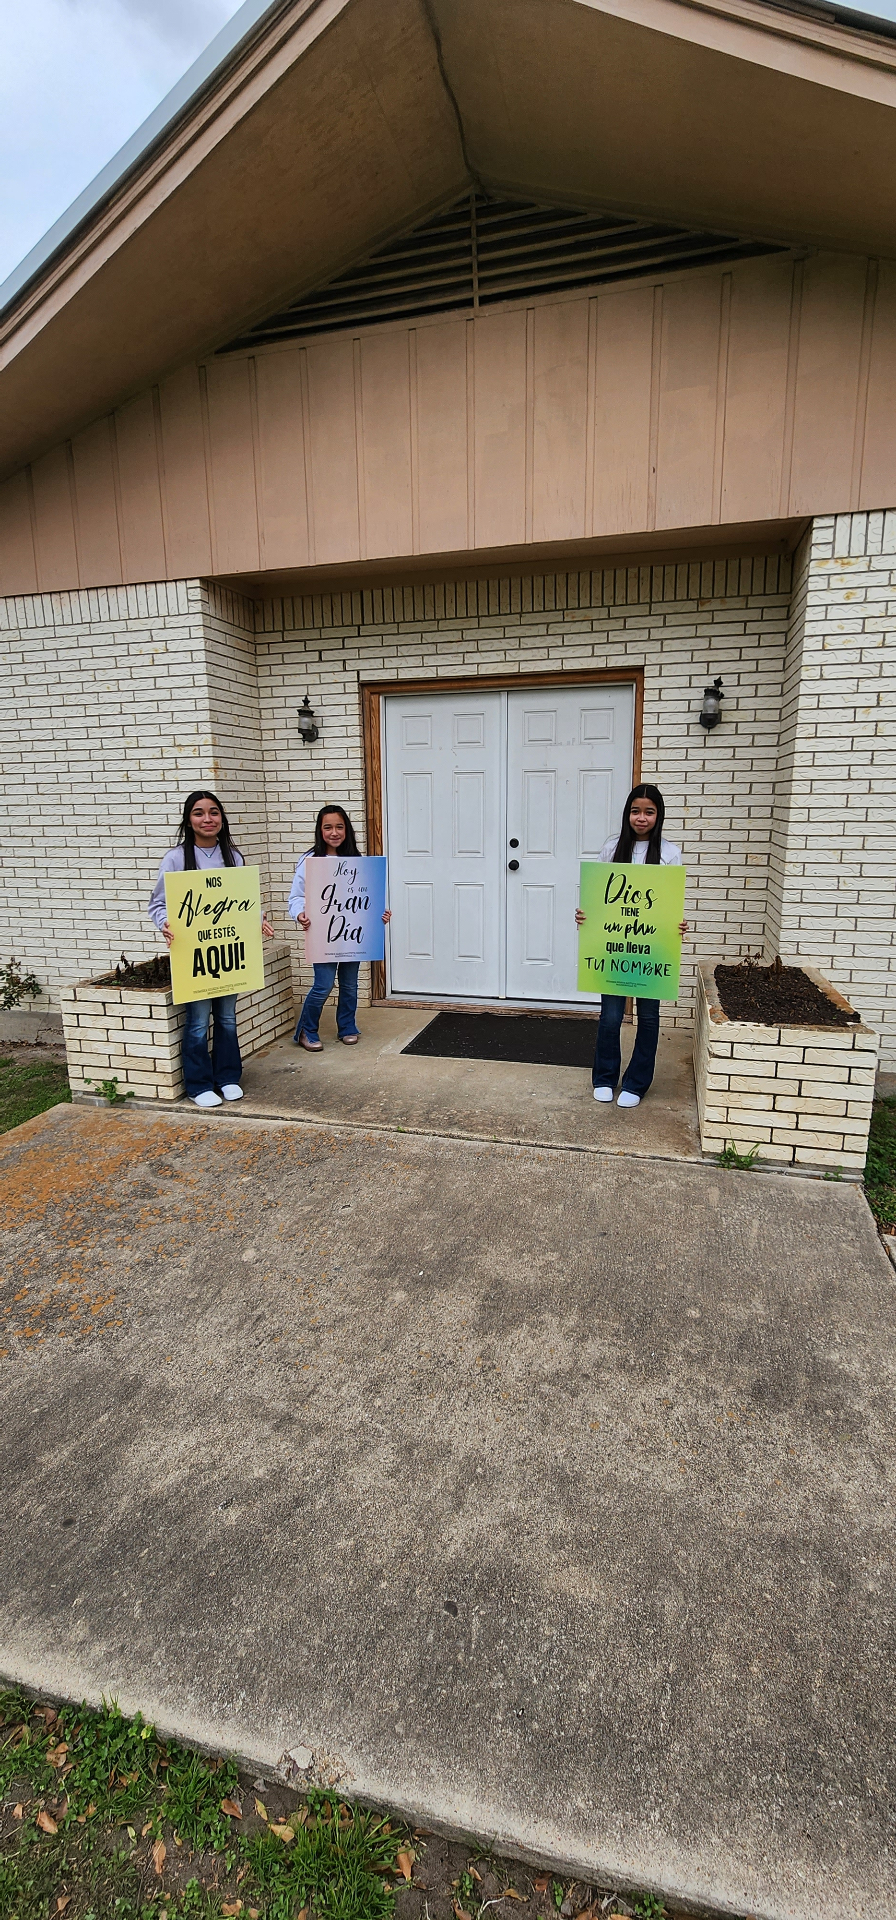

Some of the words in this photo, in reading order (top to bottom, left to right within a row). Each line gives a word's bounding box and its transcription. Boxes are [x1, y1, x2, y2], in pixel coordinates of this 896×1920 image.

[206, 877, 222, 888] NOS
[333, 861, 359, 885] Hoy
[604, 872, 658, 909] Dios
[178, 889, 255, 927] Alegra
[620, 907, 640, 917] TIENE
[198, 929, 212, 942] QUE
[214, 925, 236, 939] ESTÉS
[327, 914, 364, 944] Día
[604, 922, 623, 933] un
[624, 919, 657, 939] plan
[193, 936, 246, 979] AQUÍ!
[606, 942, 624, 954] que
[626, 942, 650, 954] lleva
[584, 957, 605, 972] TU
[610, 958, 672, 977] NOMBRE
